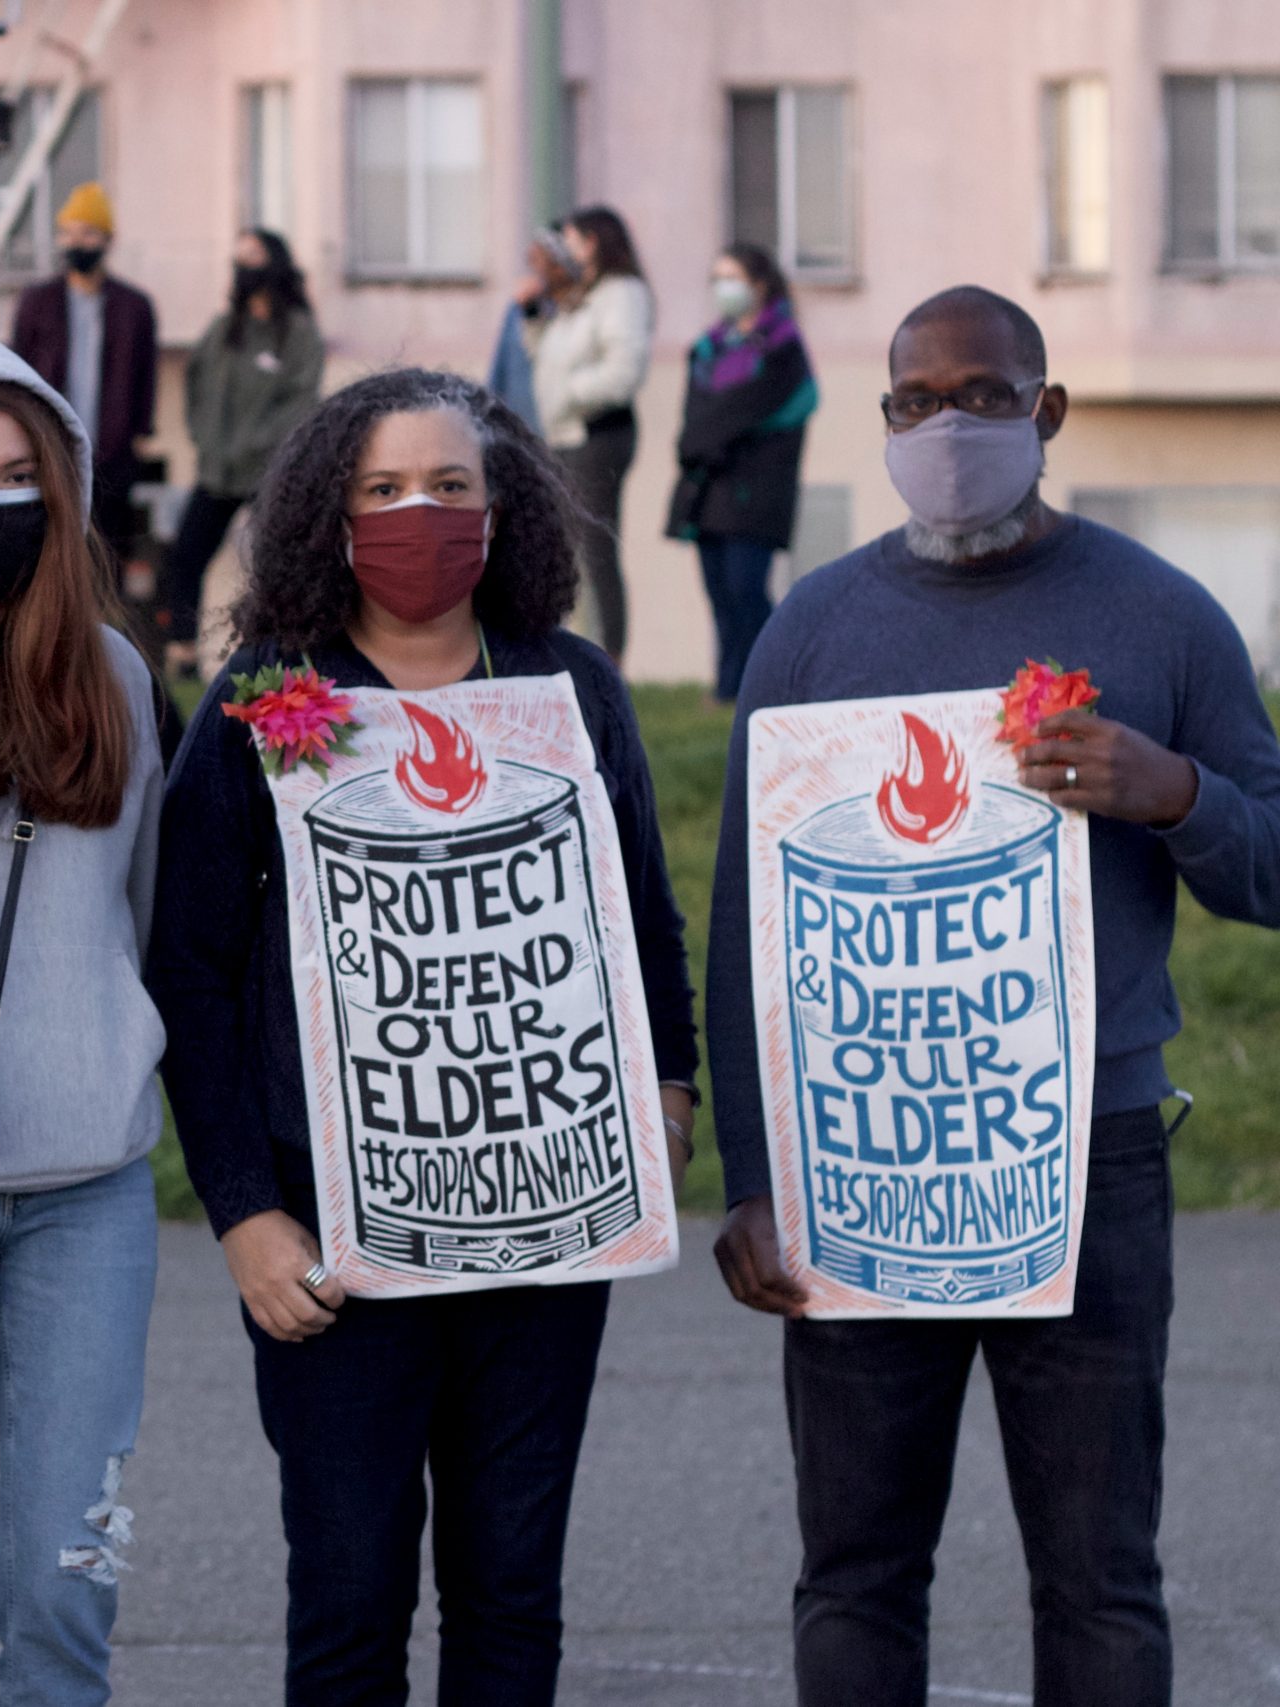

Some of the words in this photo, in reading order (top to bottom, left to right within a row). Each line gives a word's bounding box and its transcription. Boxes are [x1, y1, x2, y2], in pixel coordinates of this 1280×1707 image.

[325, 830, 571, 936] PROTECT
[792, 865, 1045, 967] PROTECT
[336, 929, 369, 978] &
[370, 933, 574, 1010] DEFEND
[795, 955, 827, 1004] &
[830, 961, 1036, 1040] DEFEND
[377, 999, 567, 1060] OUR
[833, 1035, 1021, 1088] OUR
[350, 1022, 612, 1139] ELDERS
[806, 1061, 1063, 1165] ELDERS
[360, 1103, 623, 1216] #STOPASIANHATE
[814, 1148, 1062, 1245] #STOPASIANHATE
